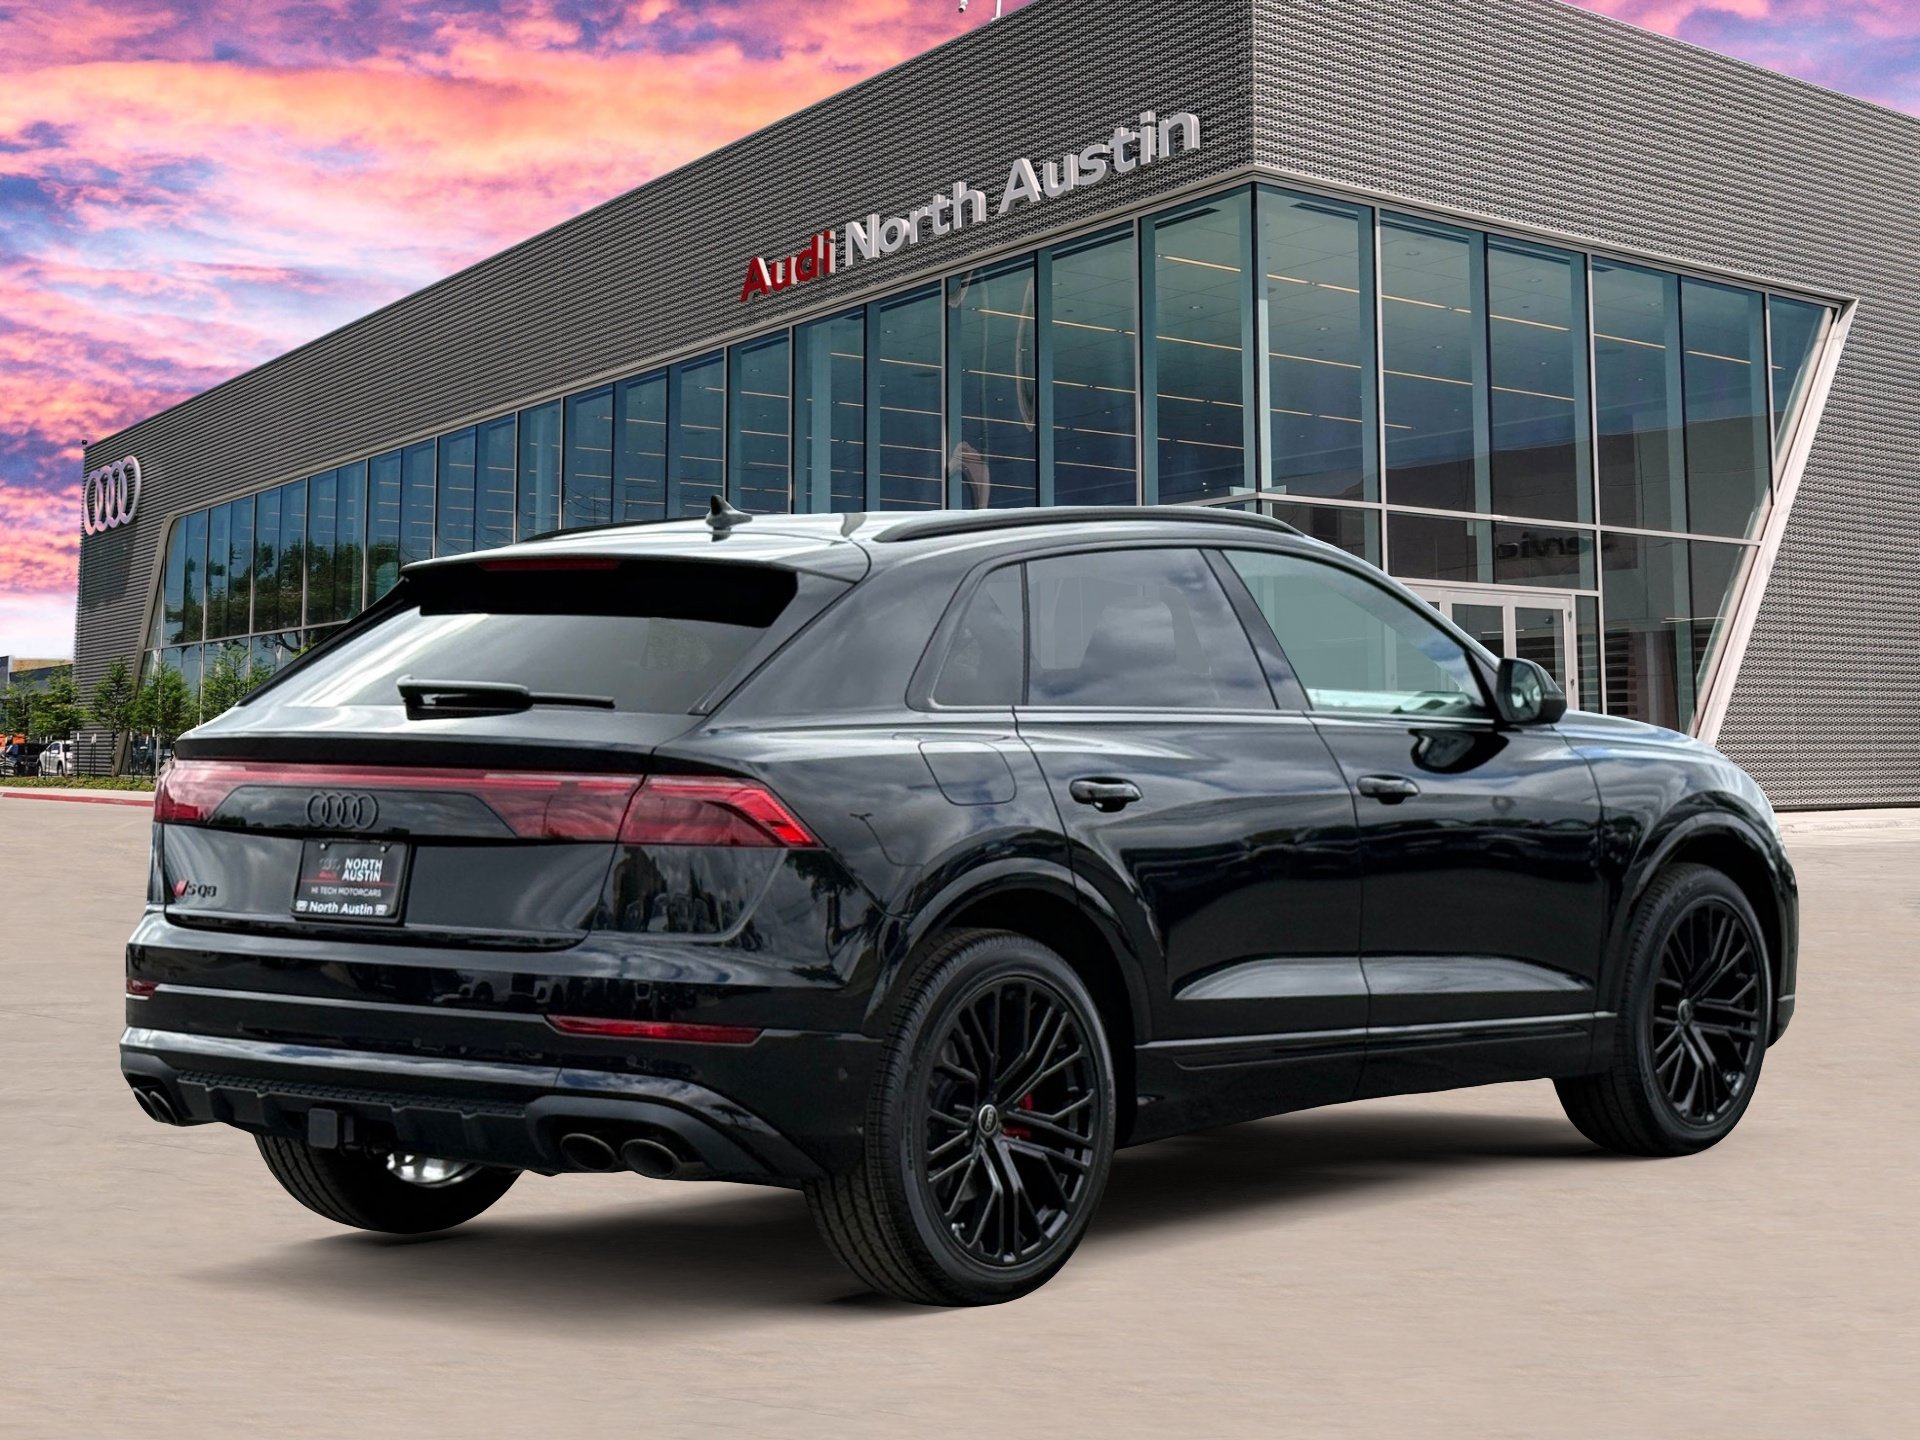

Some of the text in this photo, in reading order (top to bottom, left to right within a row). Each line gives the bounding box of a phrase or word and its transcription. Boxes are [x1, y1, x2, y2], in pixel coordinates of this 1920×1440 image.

[740, 110, 1201, 302] Audi North Austin
[344, 858, 383, 871] NORTH
[341, 870, 382, 882] AUSTIN
[320, 887, 337, 896] TECH
[338, 887, 382, 897] MOTORCARS
[309, 901, 373, 915] North Austin
